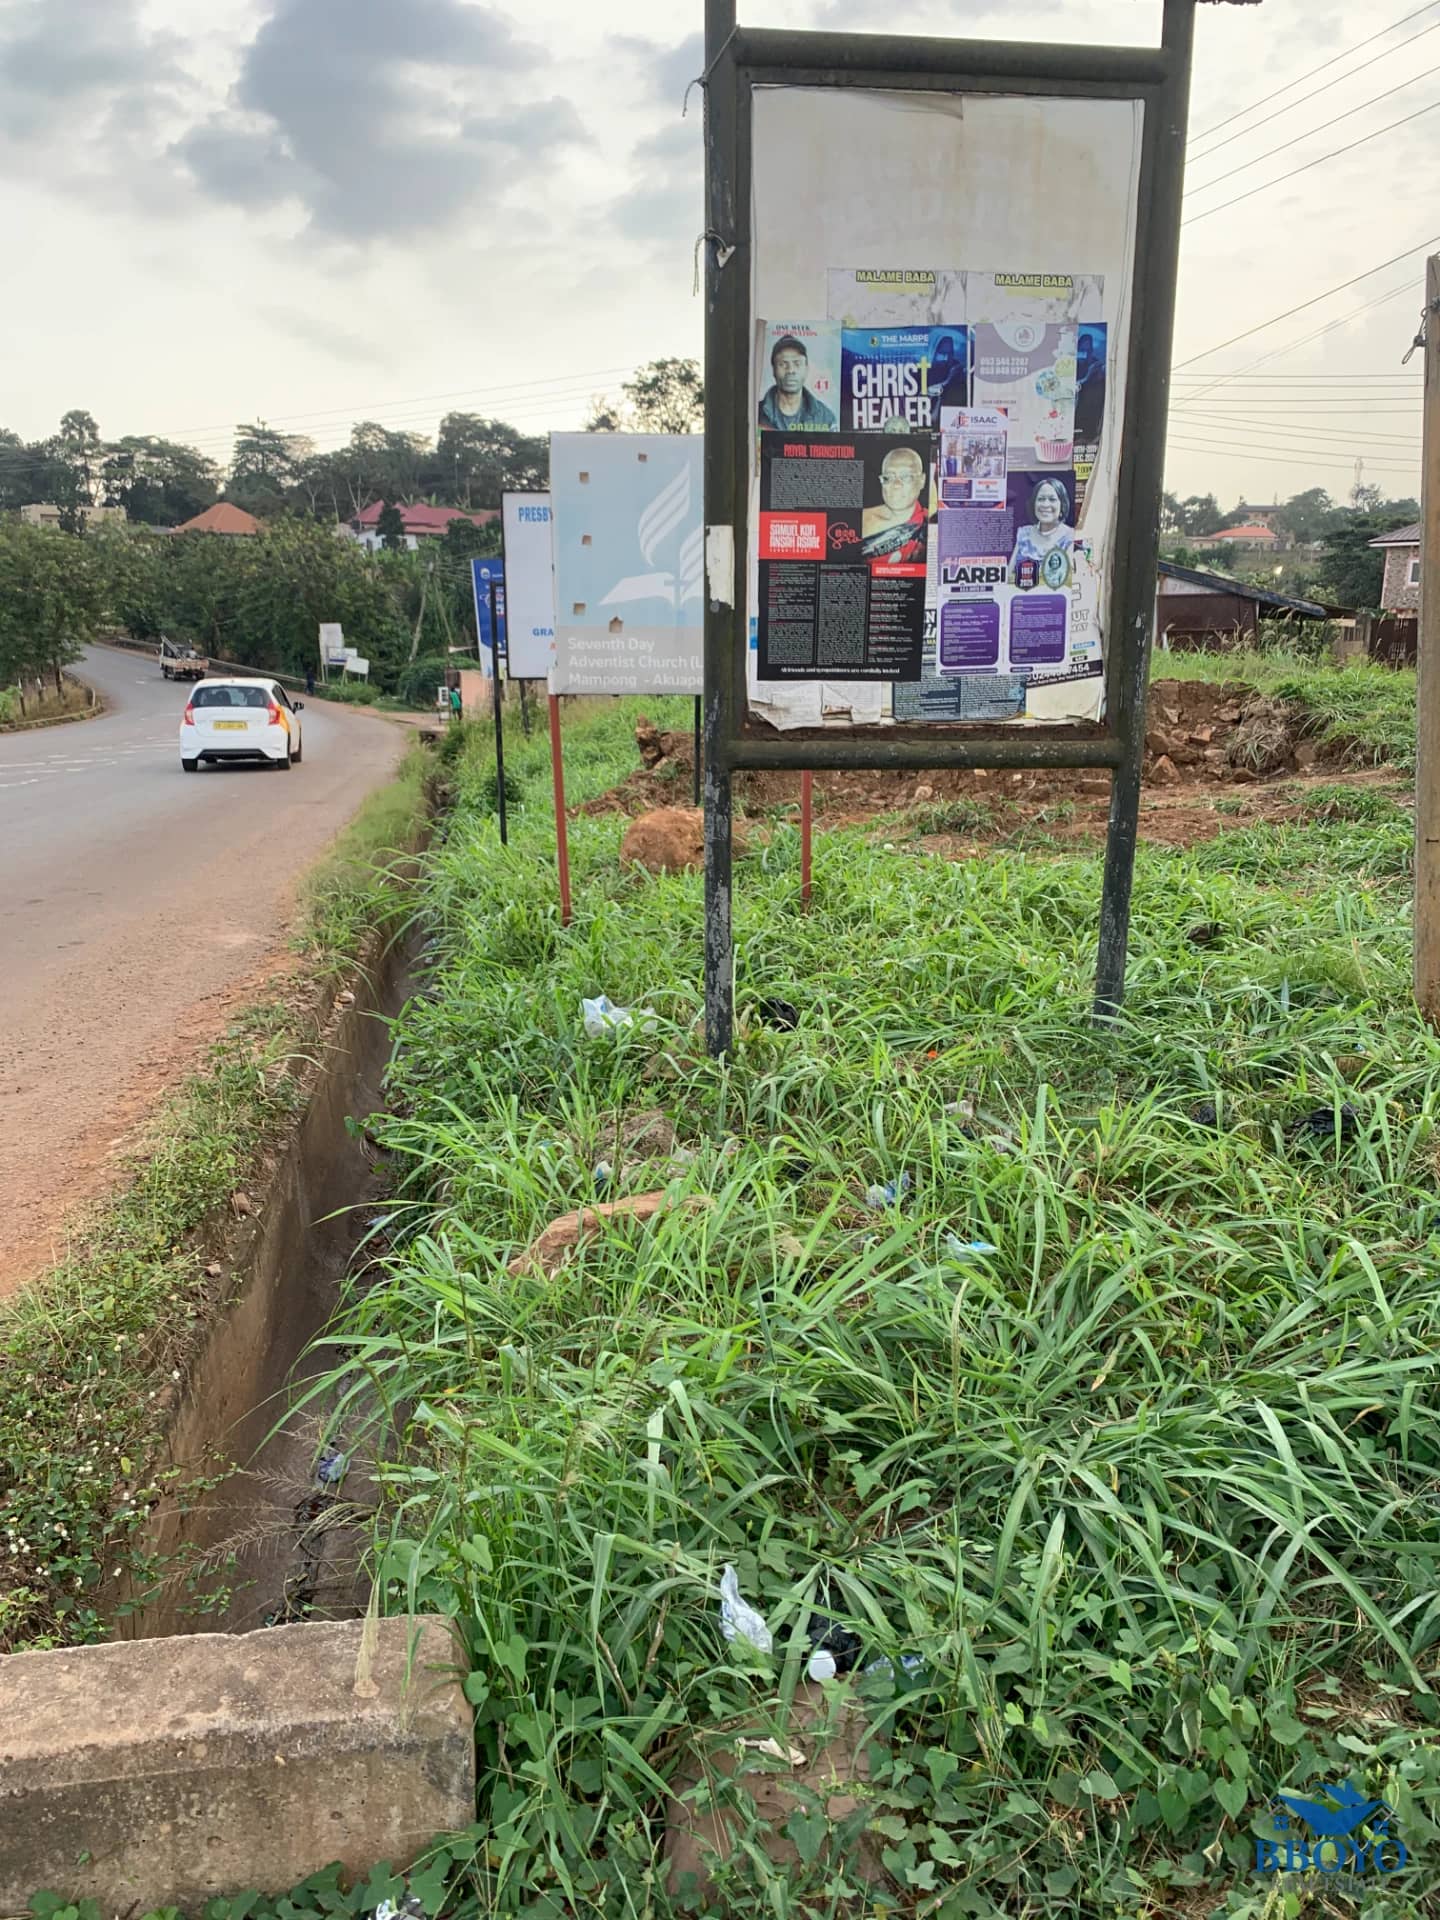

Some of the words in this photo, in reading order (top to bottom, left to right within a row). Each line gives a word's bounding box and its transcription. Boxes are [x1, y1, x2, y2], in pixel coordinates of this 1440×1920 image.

[856, 271, 903, 283] MALAME
[904, 271, 936, 284] BABA
[995, 274, 1042, 287] MALAME
[1043, 275, 1073, 288] BABA
[881, 335, 898, 343] THE
[814, 379, 830, 391] 41
[971, 415, 998, 425] ISAAC
[942, 566, 1006, 585] LARBI
[567, 638, 625, 650] Seventh
[628, 638, 656, 653] Day
[568, 655, 636, 668] Adventist
[639, 655, 687, 668] Church
[569, 672, 638, 688] Mampong
